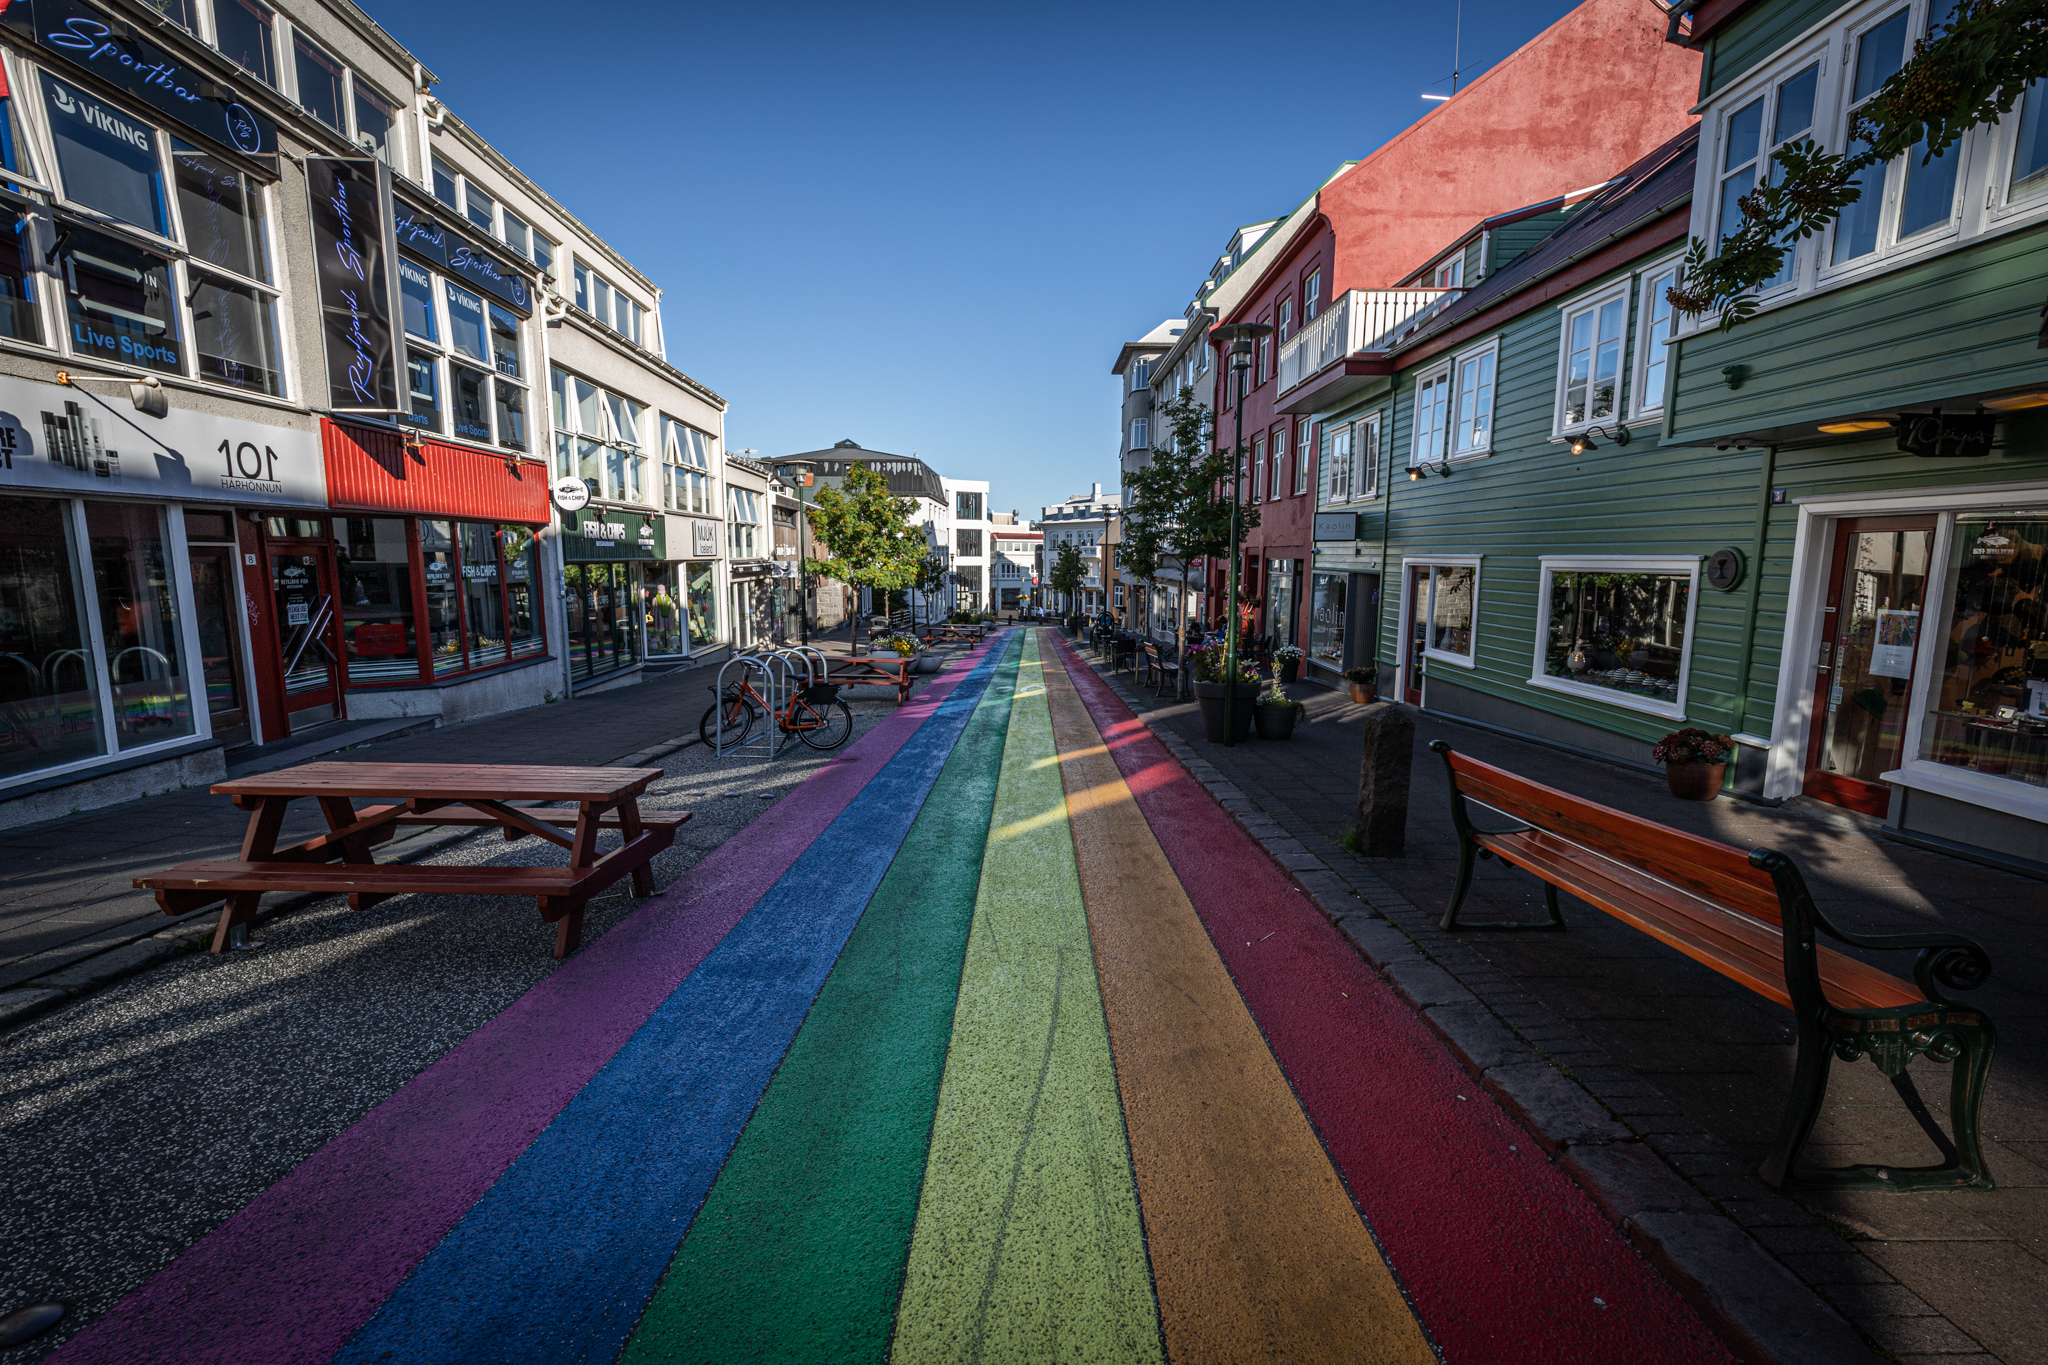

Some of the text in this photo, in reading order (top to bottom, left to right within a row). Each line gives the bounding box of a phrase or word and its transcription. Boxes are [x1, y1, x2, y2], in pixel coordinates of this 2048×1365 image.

[47, 17, 202, 104] Sportbar
[78, 101, 149, 152] VÍKING
[394, 214, 444, 248] eykjavik
[450, 247, 503, 281] Sportbar
[144, 273, 157, 289] IN
[335, 178, 375, 403] Reykjavik Sportbar
[75, 324, 177, 364] Live Sports
[408, 413, 429, 426] Darts
[454, 420, 489, 438] Live Sports
[0, 449, 13, 469] T
[217, 439, 278, 482] 101
[221, 477, 282, 494] HÁRHÖNNUN
[583, 521, 626, 540] FISH & CHIPS
[698, 523, 714, 542] MJÚK
[1319, 521, 1351, 530] Kaolin
[700, 543, 713, 554] Iceland
[248, 556, 254, 564] 8
[462, 565, 496, 577] FISH & CHIPS
[1313, 602, 1345, 627] Kaolin
